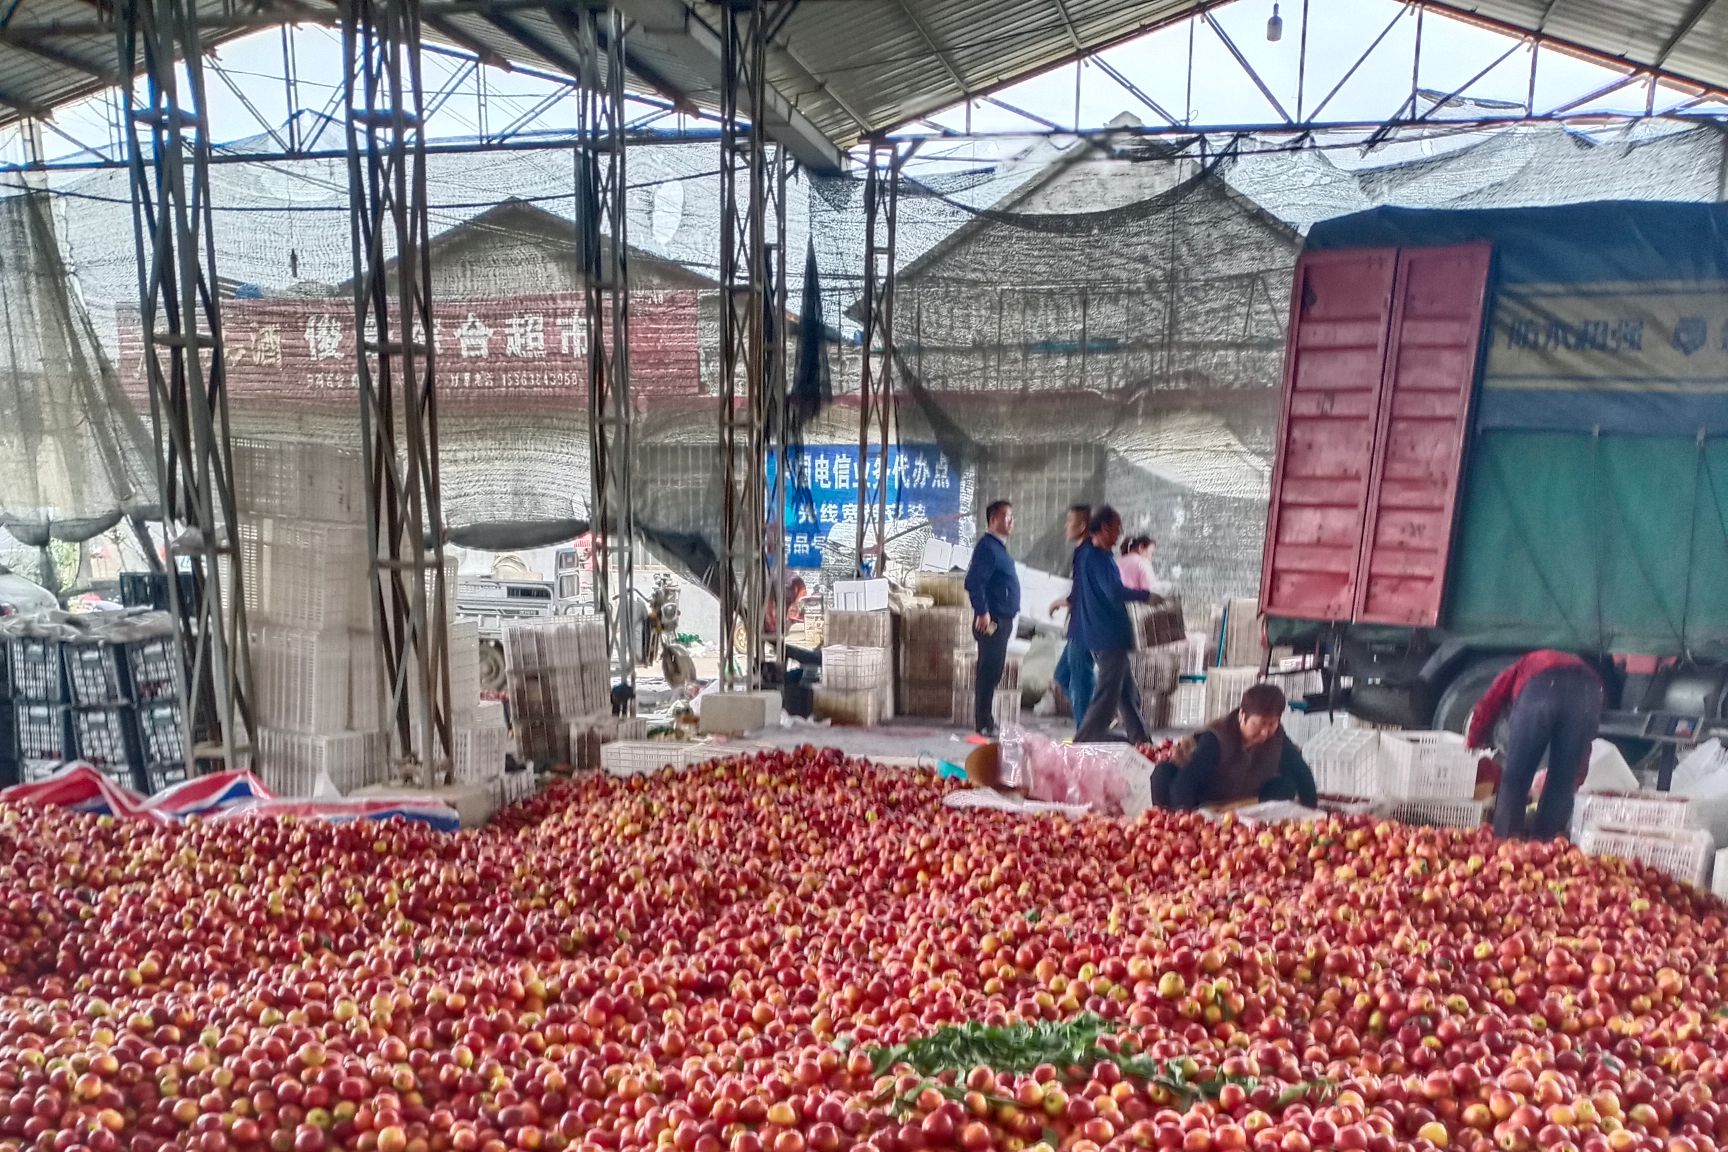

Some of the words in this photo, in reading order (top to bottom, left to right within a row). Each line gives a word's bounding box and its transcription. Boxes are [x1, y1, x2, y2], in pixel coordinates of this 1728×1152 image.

[304, 312, 592, 361] 俊综合超市
[774, 451, 950, 490] 国电信业务代办点
